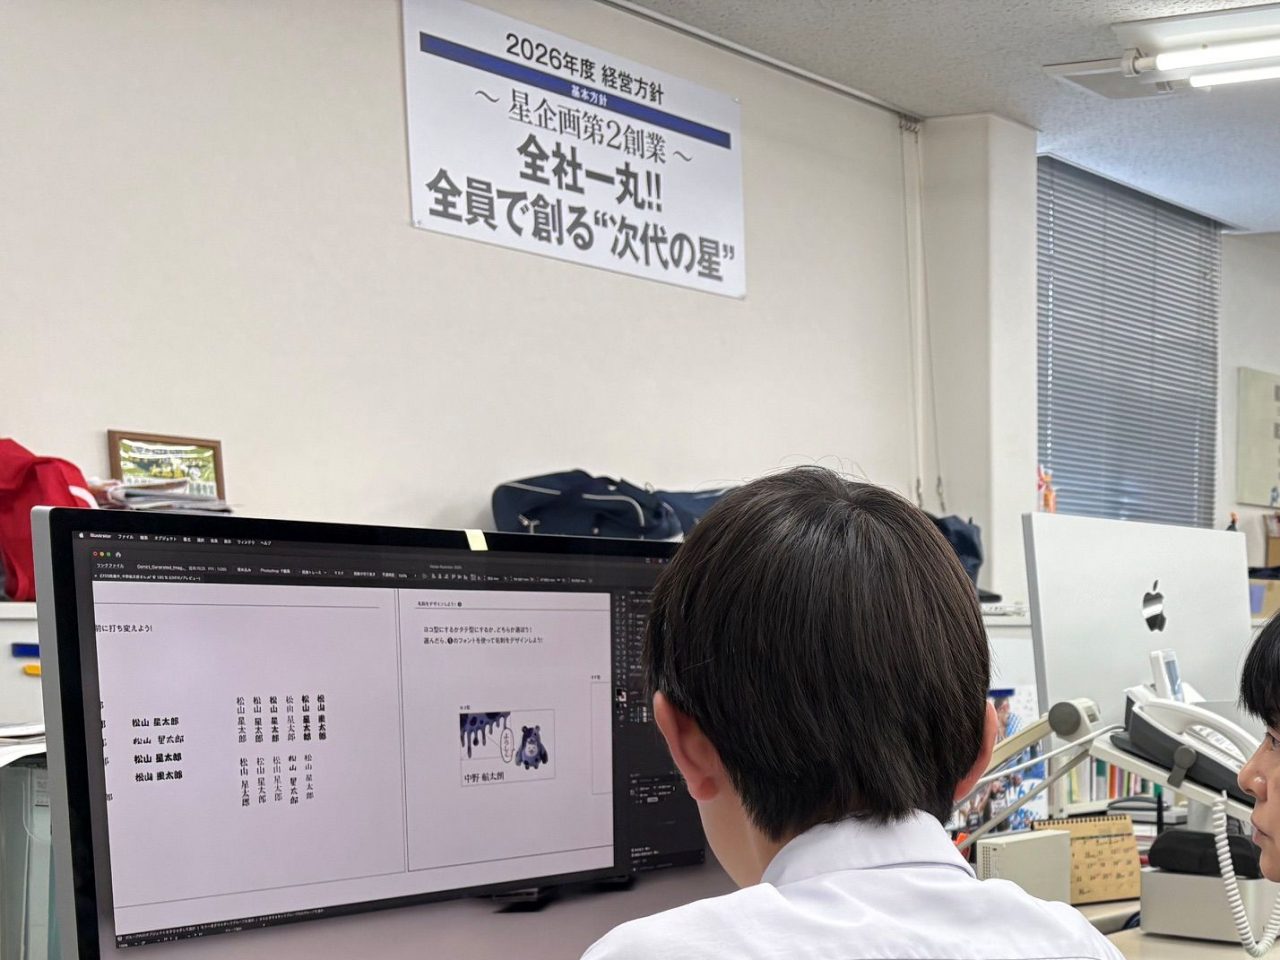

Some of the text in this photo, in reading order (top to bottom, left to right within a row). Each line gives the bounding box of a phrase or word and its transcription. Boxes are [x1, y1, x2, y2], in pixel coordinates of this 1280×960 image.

[505, 32, 664, 105] 2026年度 経営方針
[570, 84, 608, 107] 基本方針
[132, 718, 150, 728] 松山
[134, 752, 182, 764] 松山 星太郎
